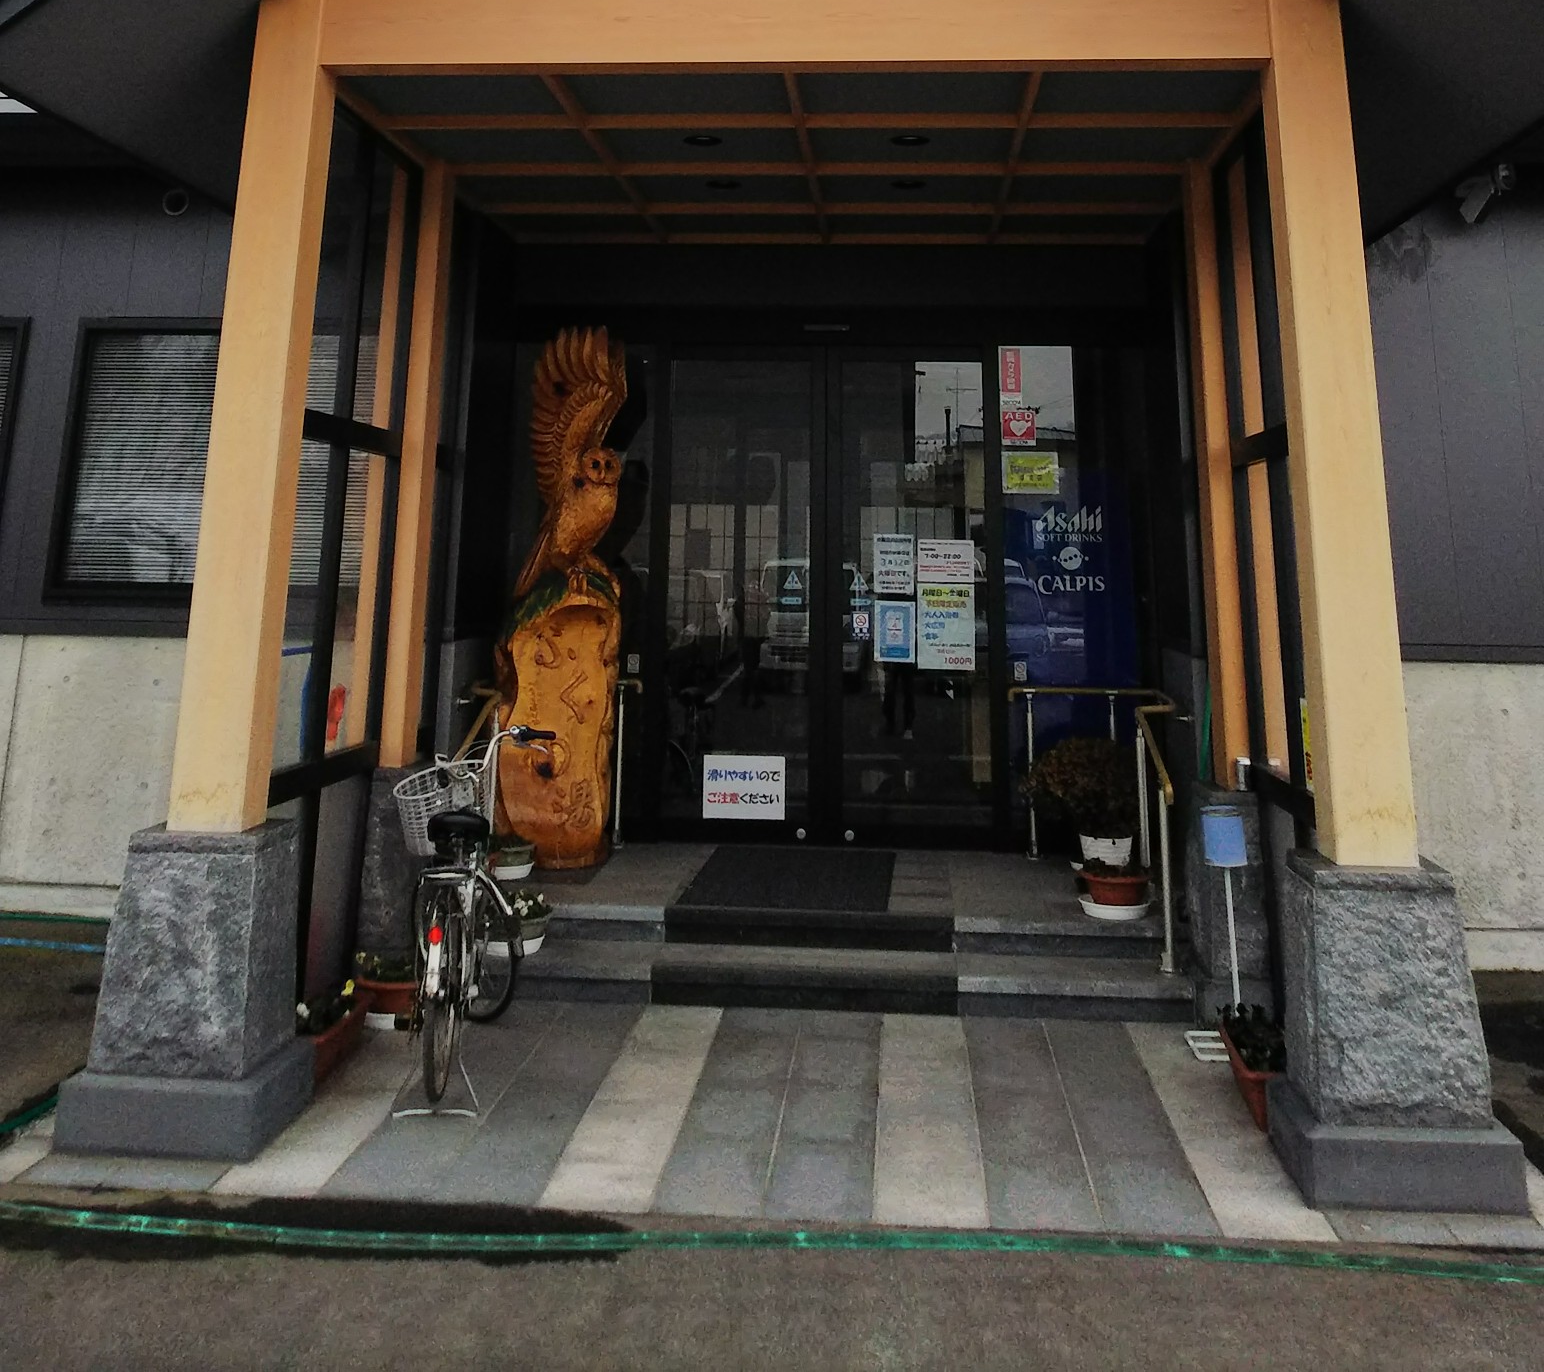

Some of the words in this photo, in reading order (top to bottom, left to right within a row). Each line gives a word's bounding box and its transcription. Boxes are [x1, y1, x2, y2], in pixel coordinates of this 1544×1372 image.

[1004, 412, 1033, 420] AED
[1035, 505, 1102, 532] Asahi
[1036, 533, 1062, 542] SOFT
[1064, 533, 1103, 542] DRINKS
[1037, 574, 1106, 595] CALPIS
[707, 769, 781, 781] 滑りやすいので
[707, 792, 780, 804] ご注意ください
